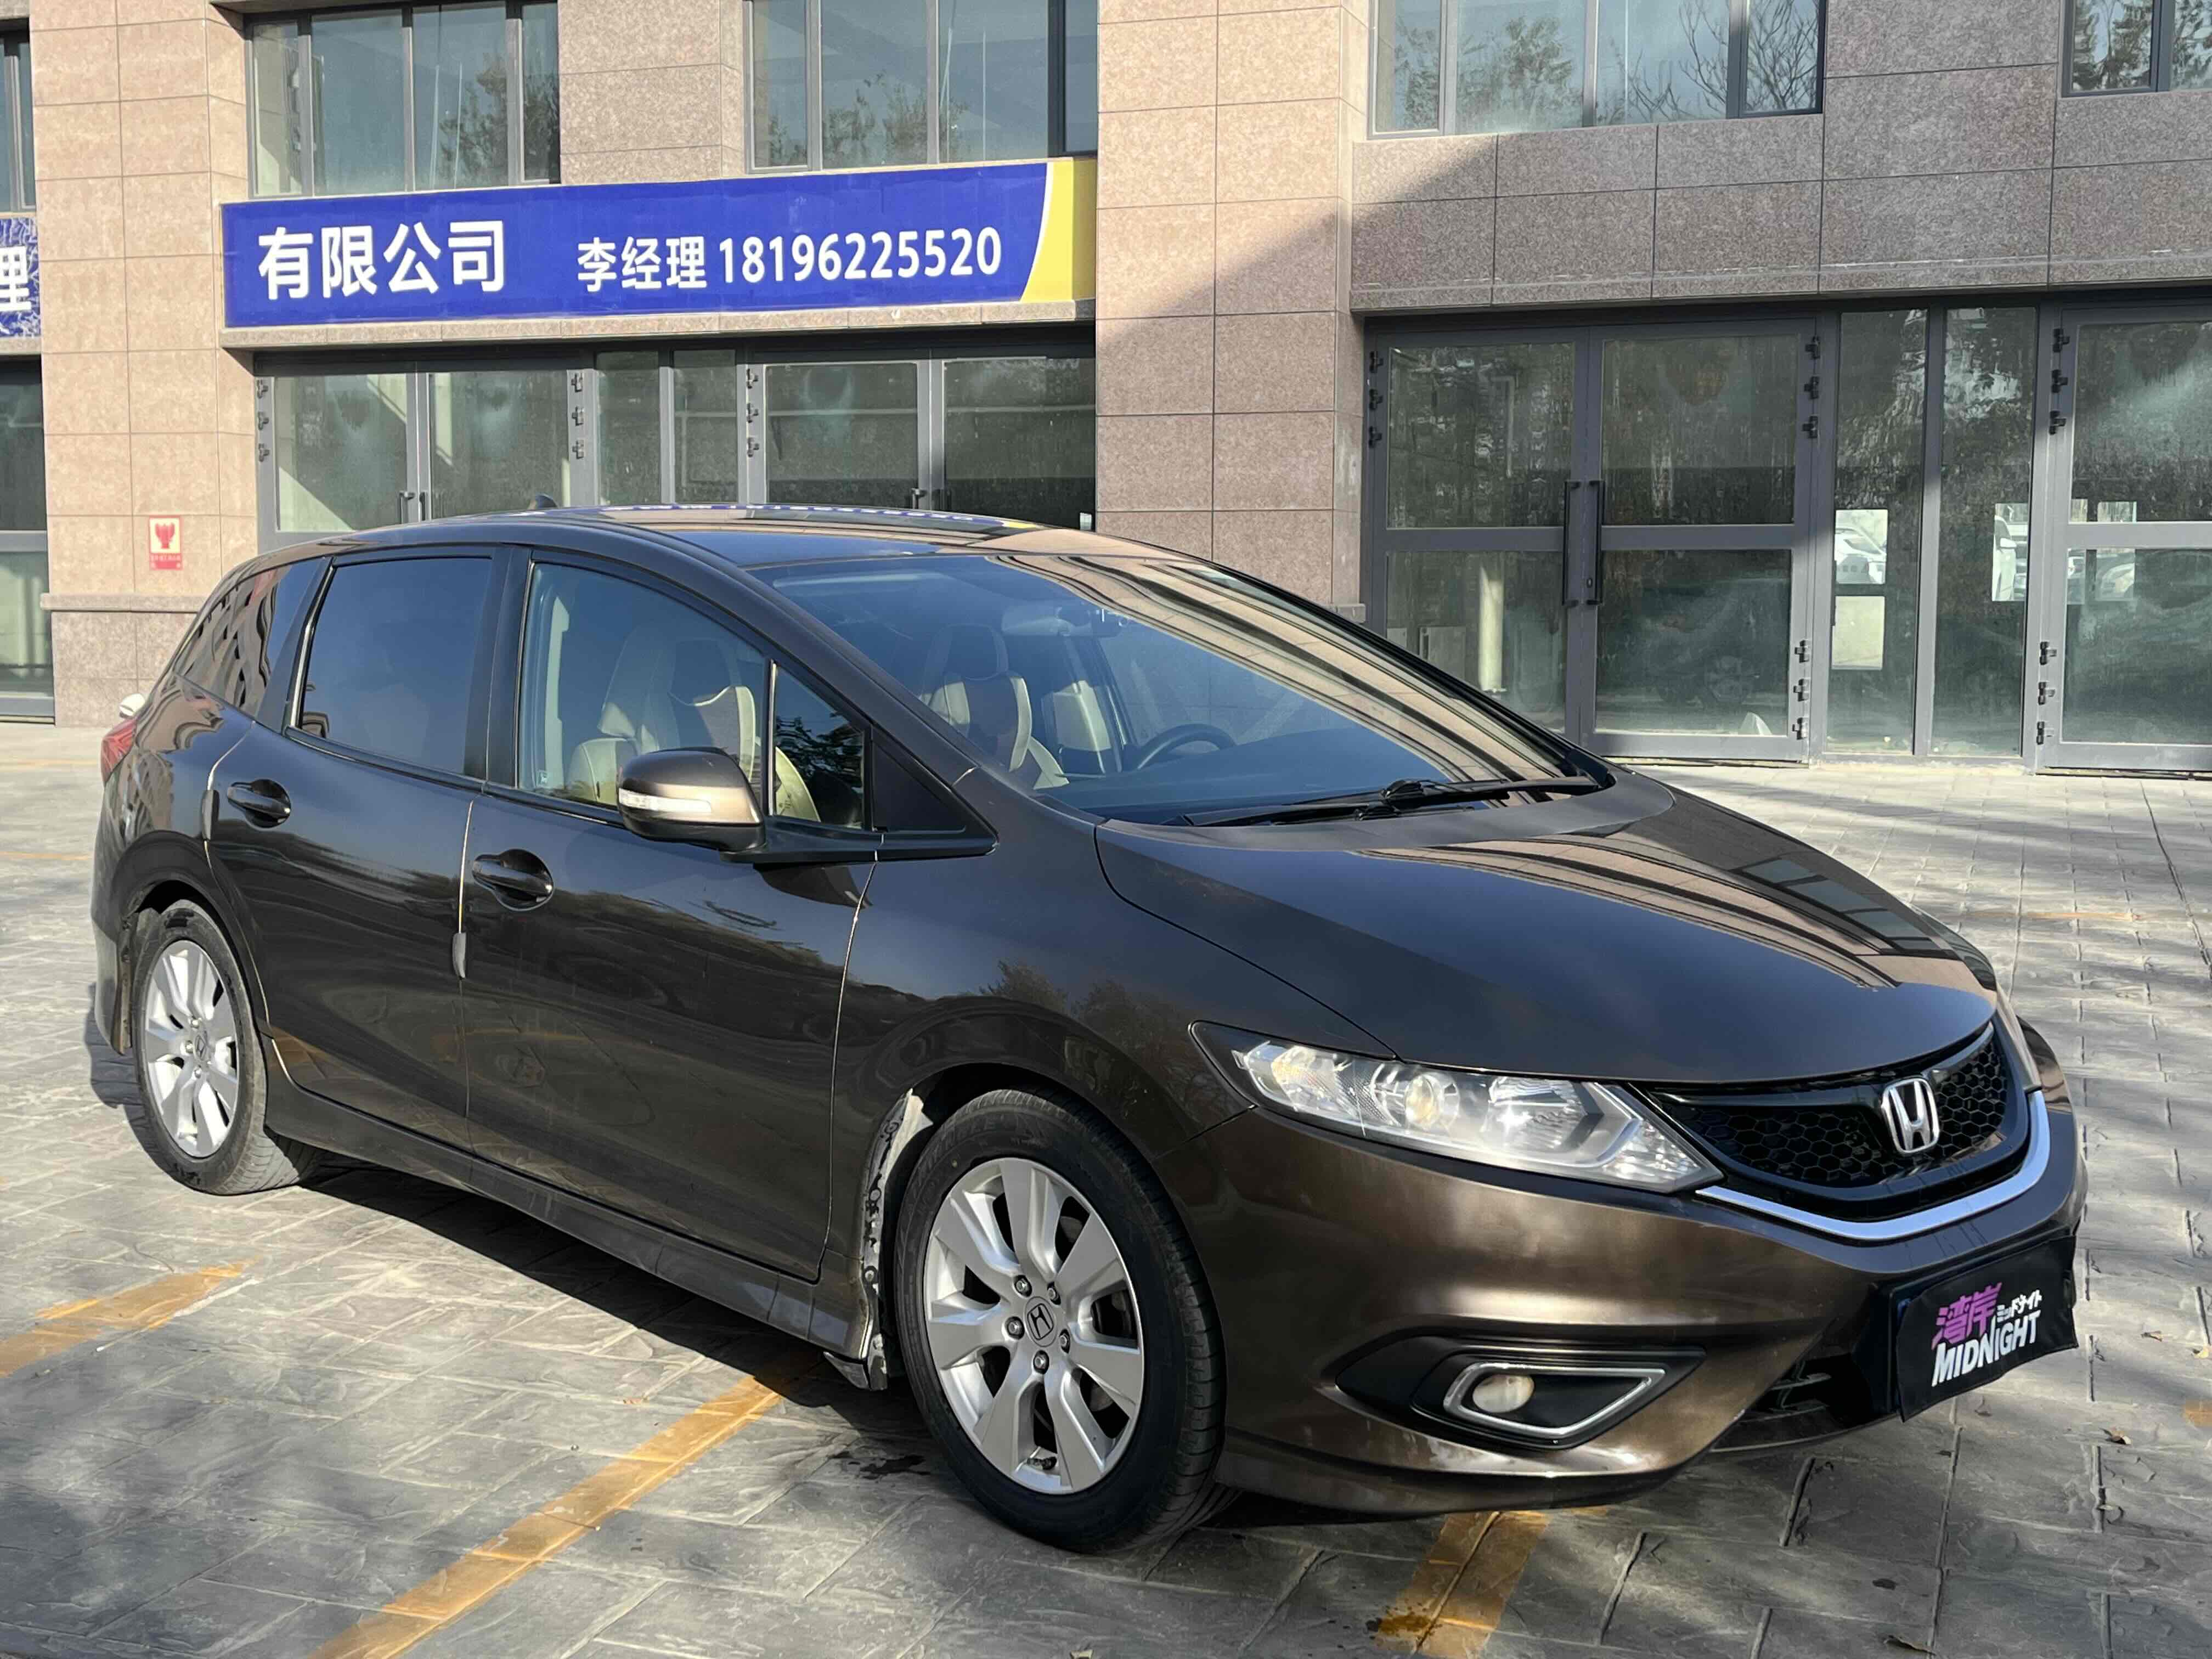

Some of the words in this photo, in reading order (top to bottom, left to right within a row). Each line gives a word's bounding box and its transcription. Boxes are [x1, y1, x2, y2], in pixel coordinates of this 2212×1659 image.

[258, 221, 504, 300] 有限公司
[578, 236, 707, 292] 李经理
[719, 227, 1002, 284] 18196225520
[1931, 1282, 2002, 1350] 湾岸
[1932, 1310, 2041, 1387] MIDNIGHT
